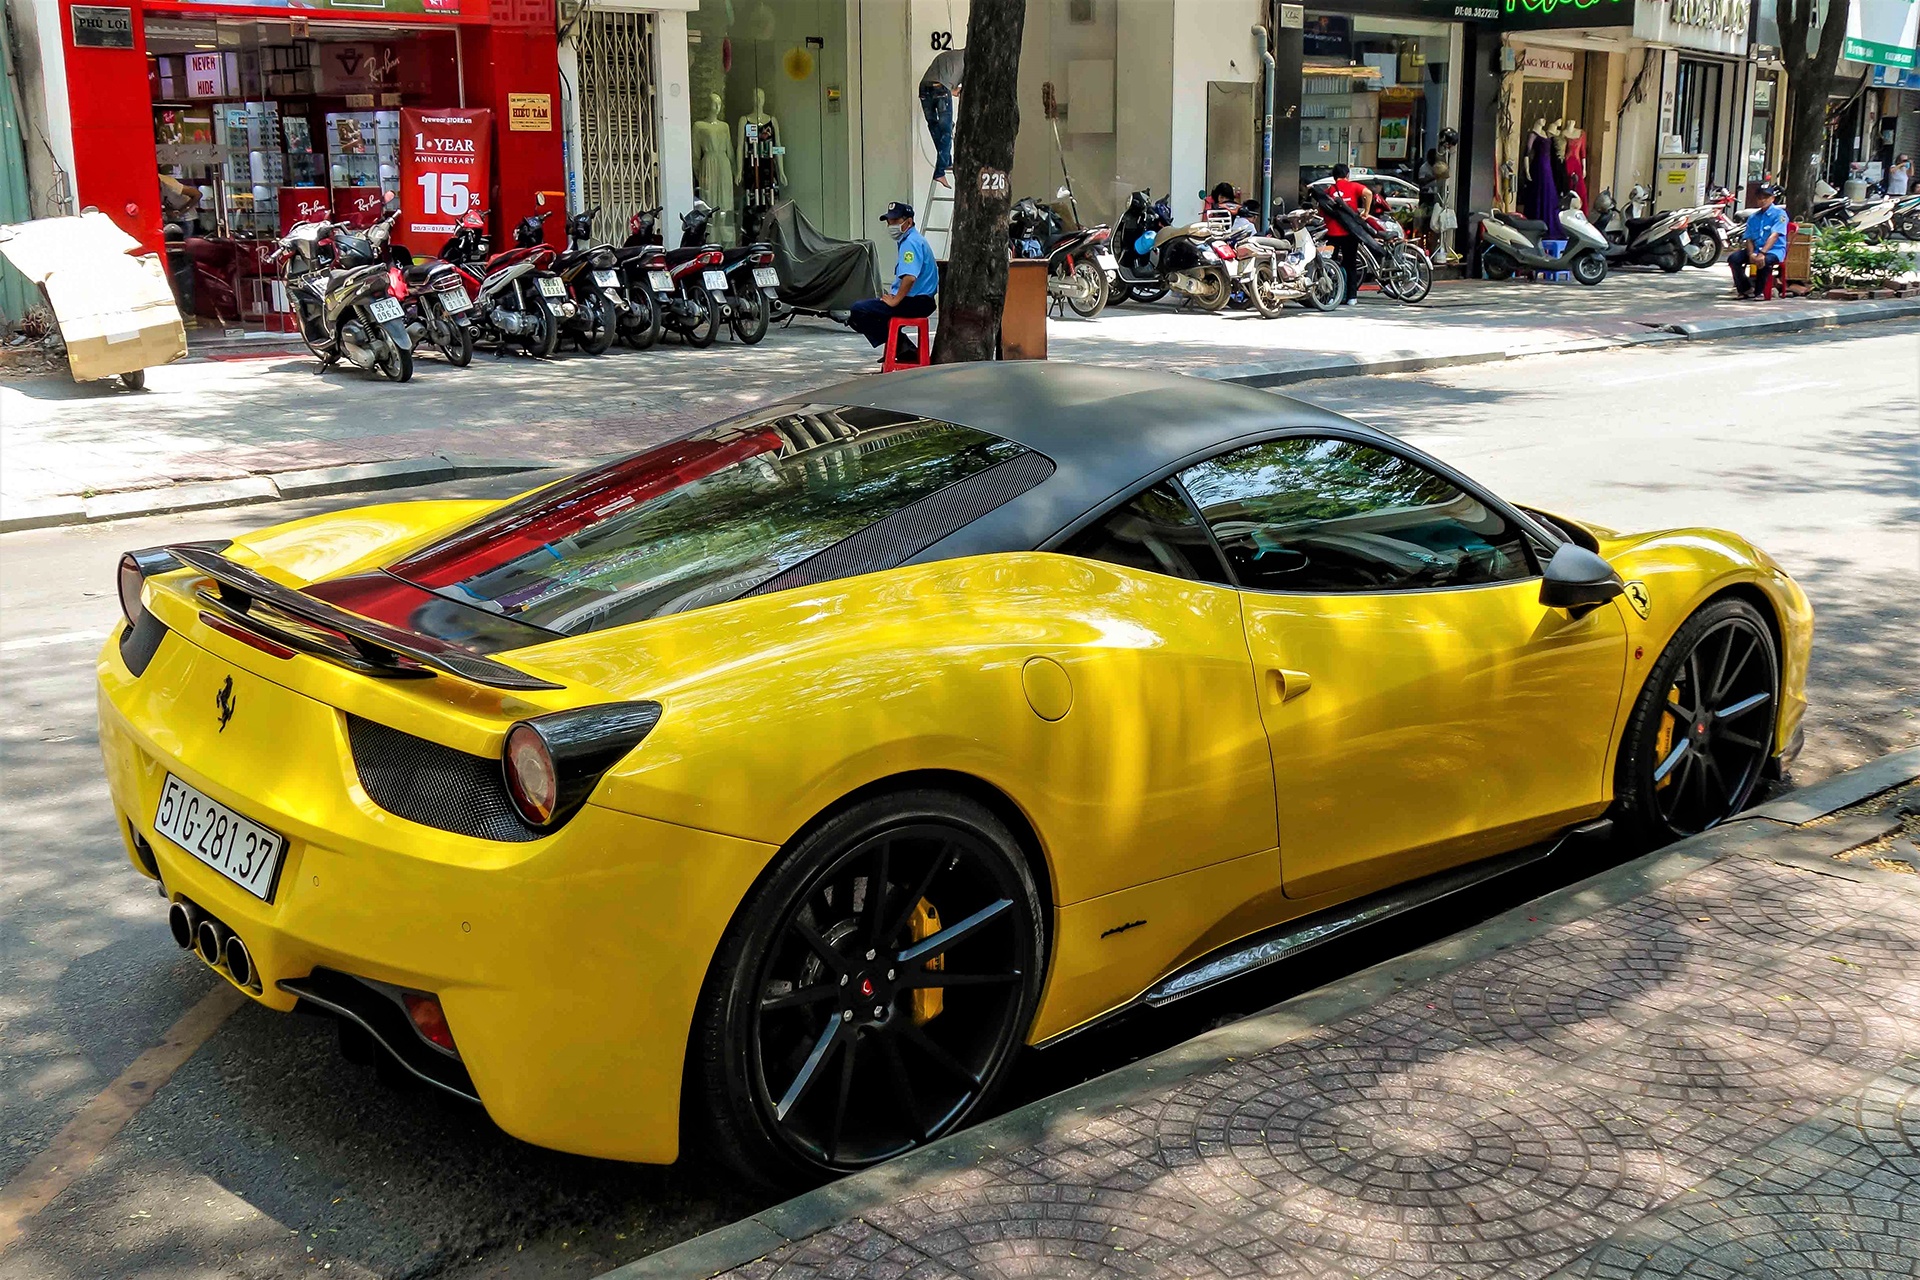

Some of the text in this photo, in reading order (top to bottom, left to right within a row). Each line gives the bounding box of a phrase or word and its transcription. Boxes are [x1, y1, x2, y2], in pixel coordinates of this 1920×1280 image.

[931, 32, 952, 50] 82
[192, 56, 216, 71] NEVER
[197, 80, 215, 95] HIDE
[434, 138, 475, 152] YEAR
[414, 156, 474, 164] ANNIVERSARY
[982, 173, 1005, 190] 226
[161, 782, 273, 884] 51G-281.37
